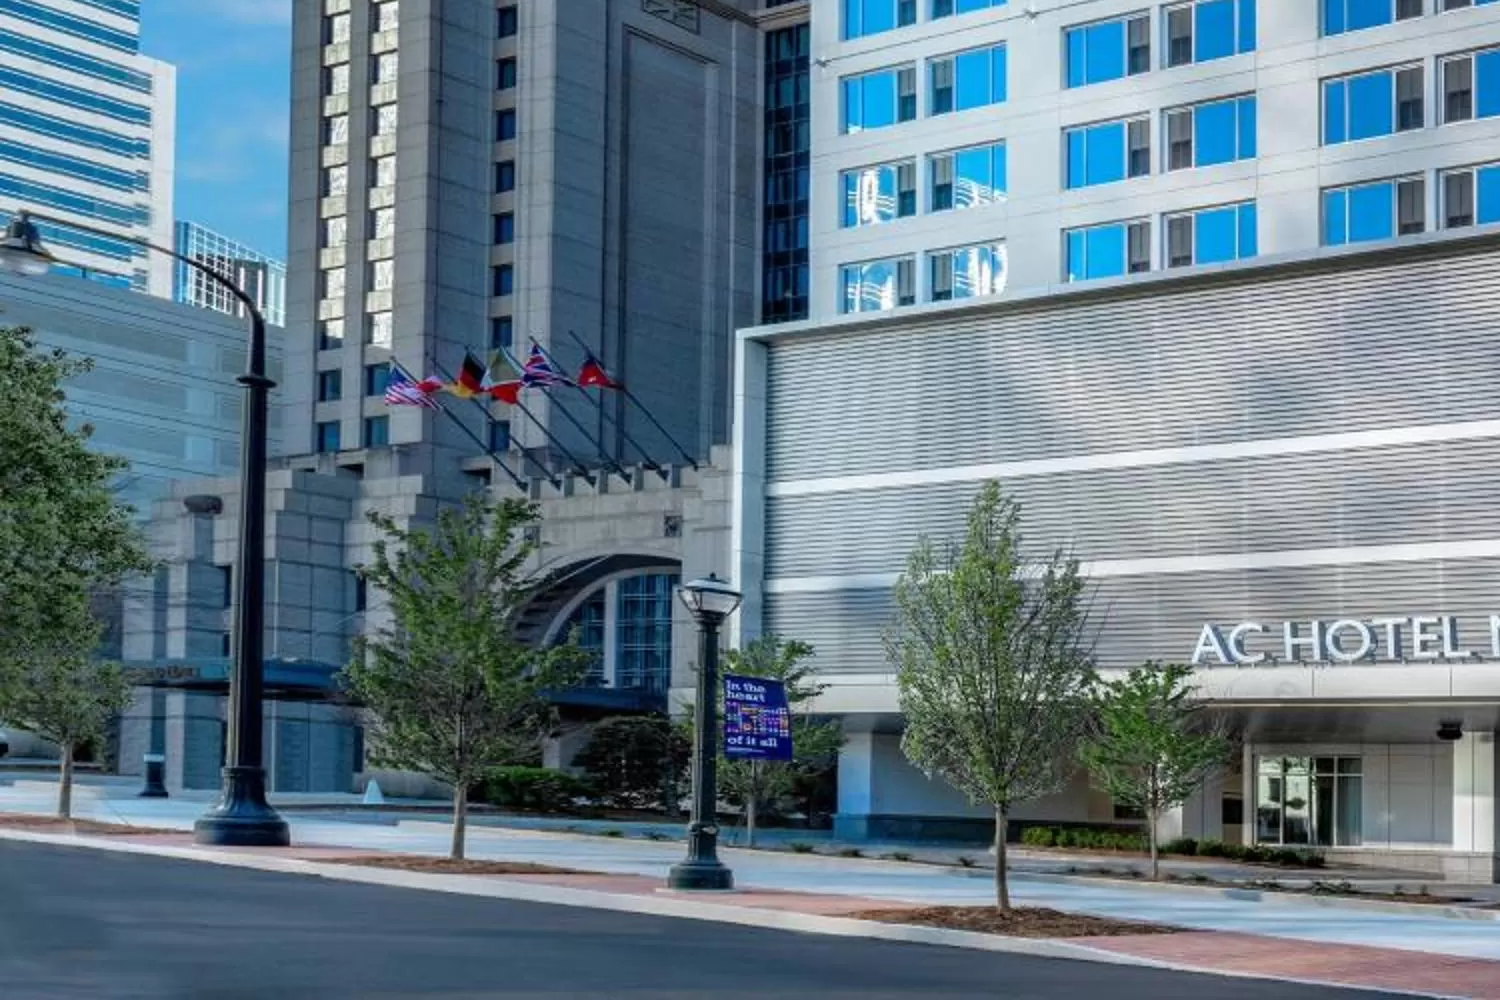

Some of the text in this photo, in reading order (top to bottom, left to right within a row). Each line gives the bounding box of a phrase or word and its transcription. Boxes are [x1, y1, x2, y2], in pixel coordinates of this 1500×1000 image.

[1191, 621, 1267, 664] AC
[1283, 615, 1472, 662] HOTEL
[726, 680, 766, 693] In the
[727, 690, 766, 702] heart
[727, 736, 778, 748] of it all
